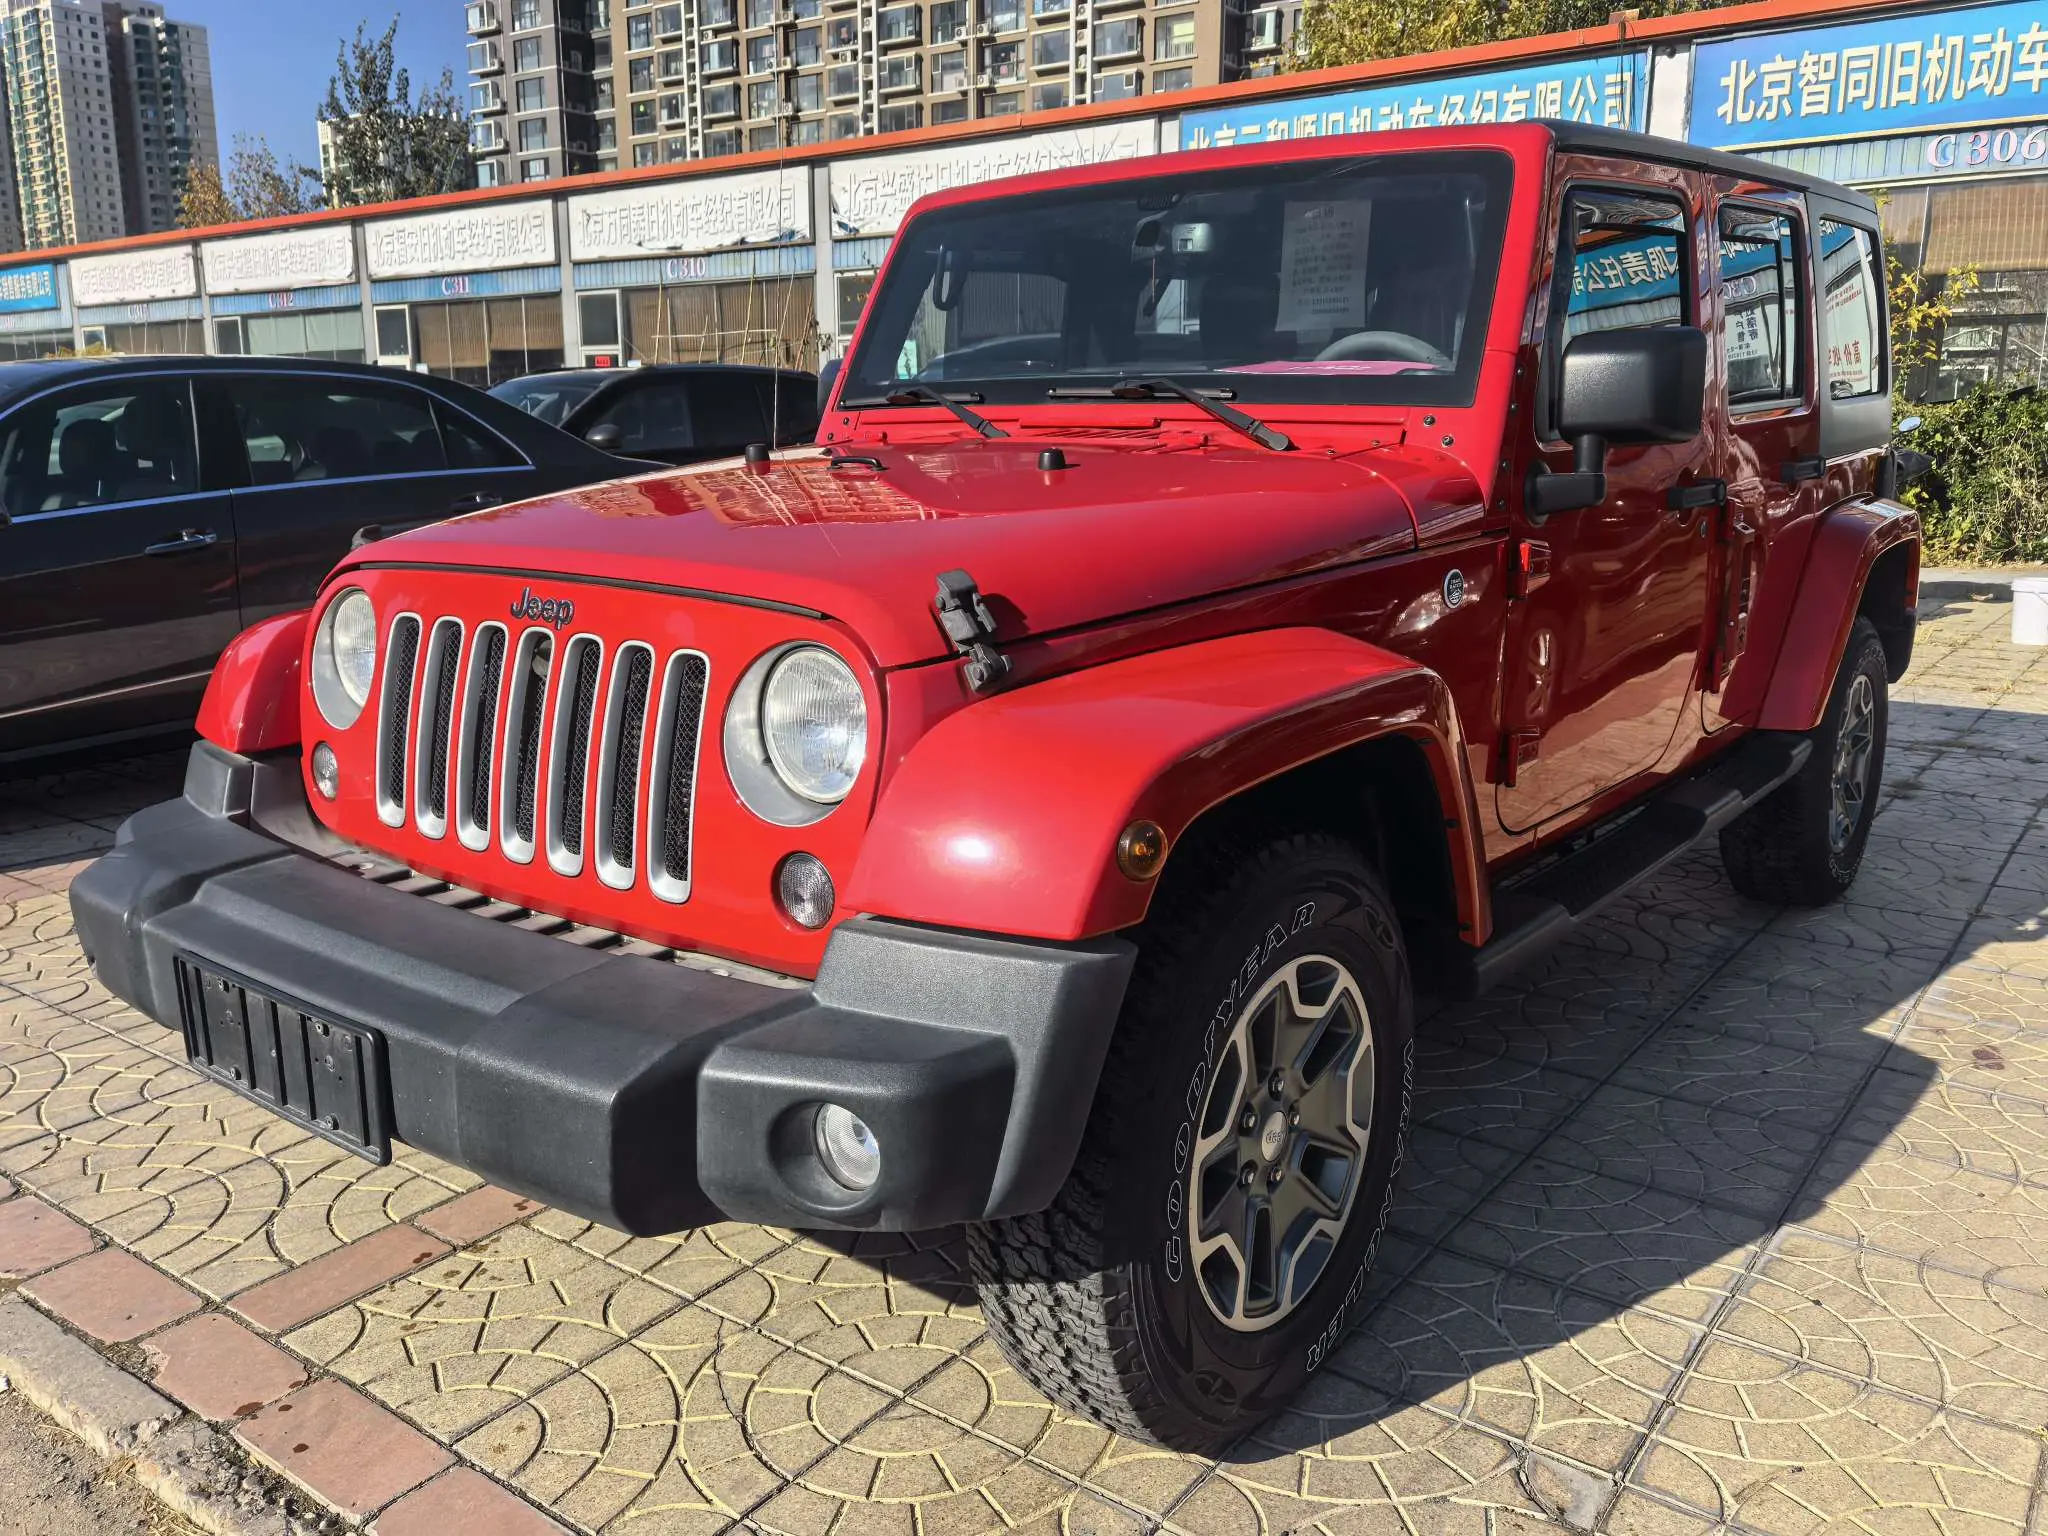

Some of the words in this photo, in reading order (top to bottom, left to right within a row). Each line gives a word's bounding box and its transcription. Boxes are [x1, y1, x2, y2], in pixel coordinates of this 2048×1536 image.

[1716, 21, 2048, 126] 北京智同旧机动车
[441, 275, 470, 296] C311
[510, 586, 575, 630] Jeep
[1165, 900, 1317, 1283] GOODYEAR
